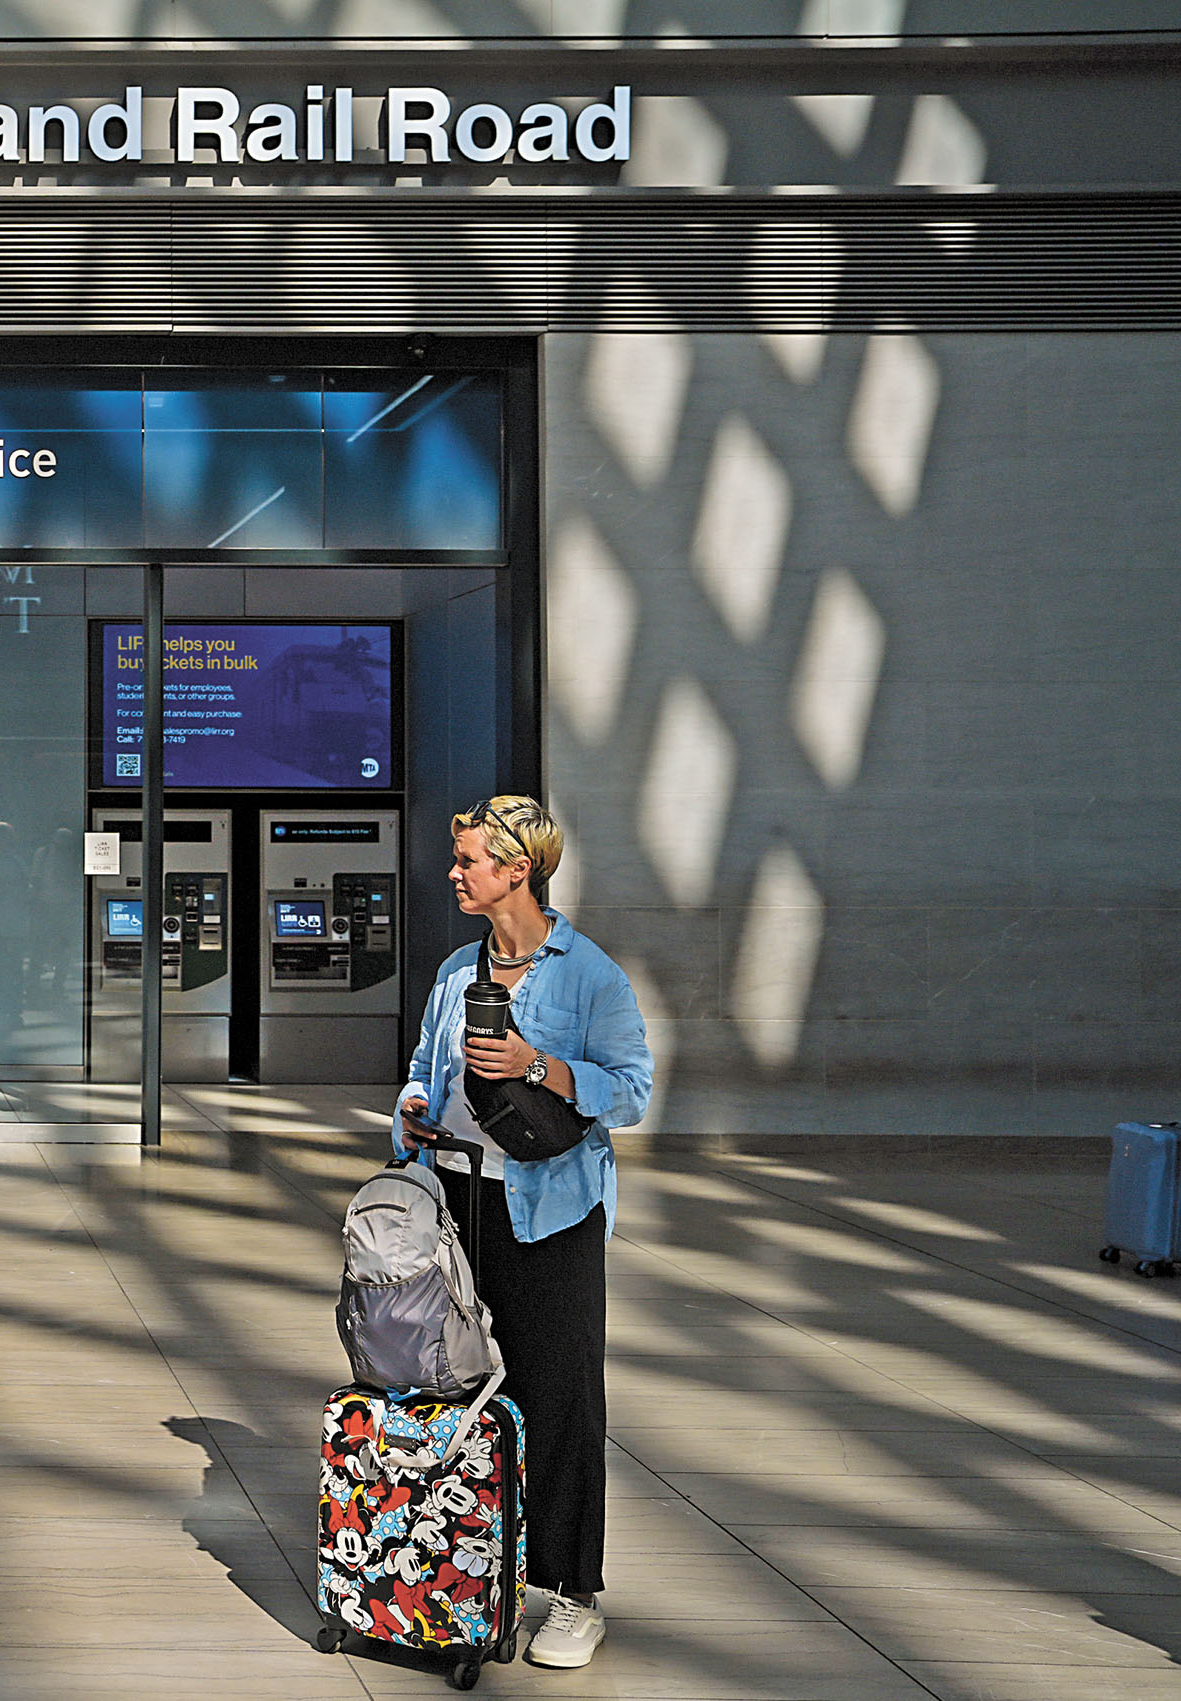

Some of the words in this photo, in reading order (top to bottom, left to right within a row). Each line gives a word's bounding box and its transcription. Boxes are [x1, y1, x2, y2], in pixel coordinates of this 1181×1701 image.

[177, 85, 353, 163] Rail
[386, 84, 631, 163] Road
[117, 635, 145, 651] LIR
[206, 639, 236, 654] you
[162, 655, 204, 670] ckets
[207, 655, 221, 670] in
[223, 655, 259, 670] bulk
[116, 708, 130, 718] For
